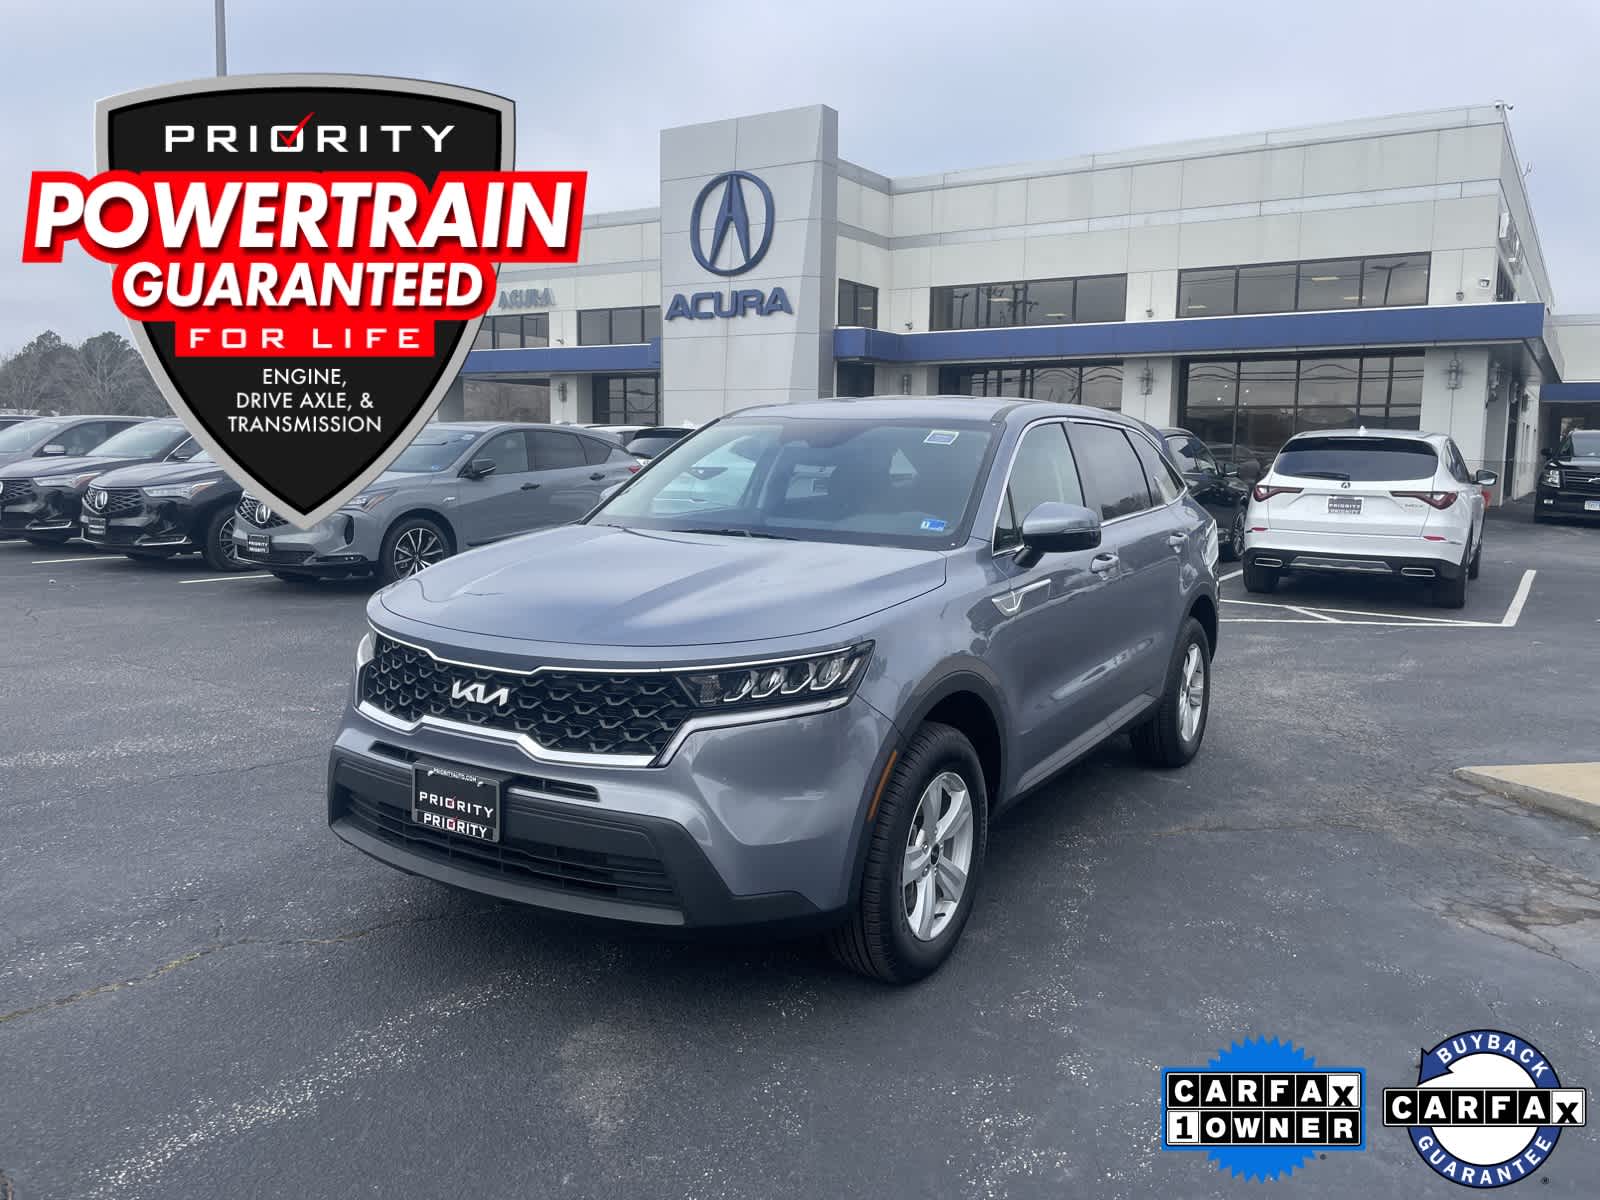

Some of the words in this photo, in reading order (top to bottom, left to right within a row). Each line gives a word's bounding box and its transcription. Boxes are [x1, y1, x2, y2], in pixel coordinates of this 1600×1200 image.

[498, 287, 555, 309] ACURA
[664, 286, 793, 321] ACURA
[419, 791, 494, 819] PRIORITY
[423, 812, 488, 838] PRIORITY
